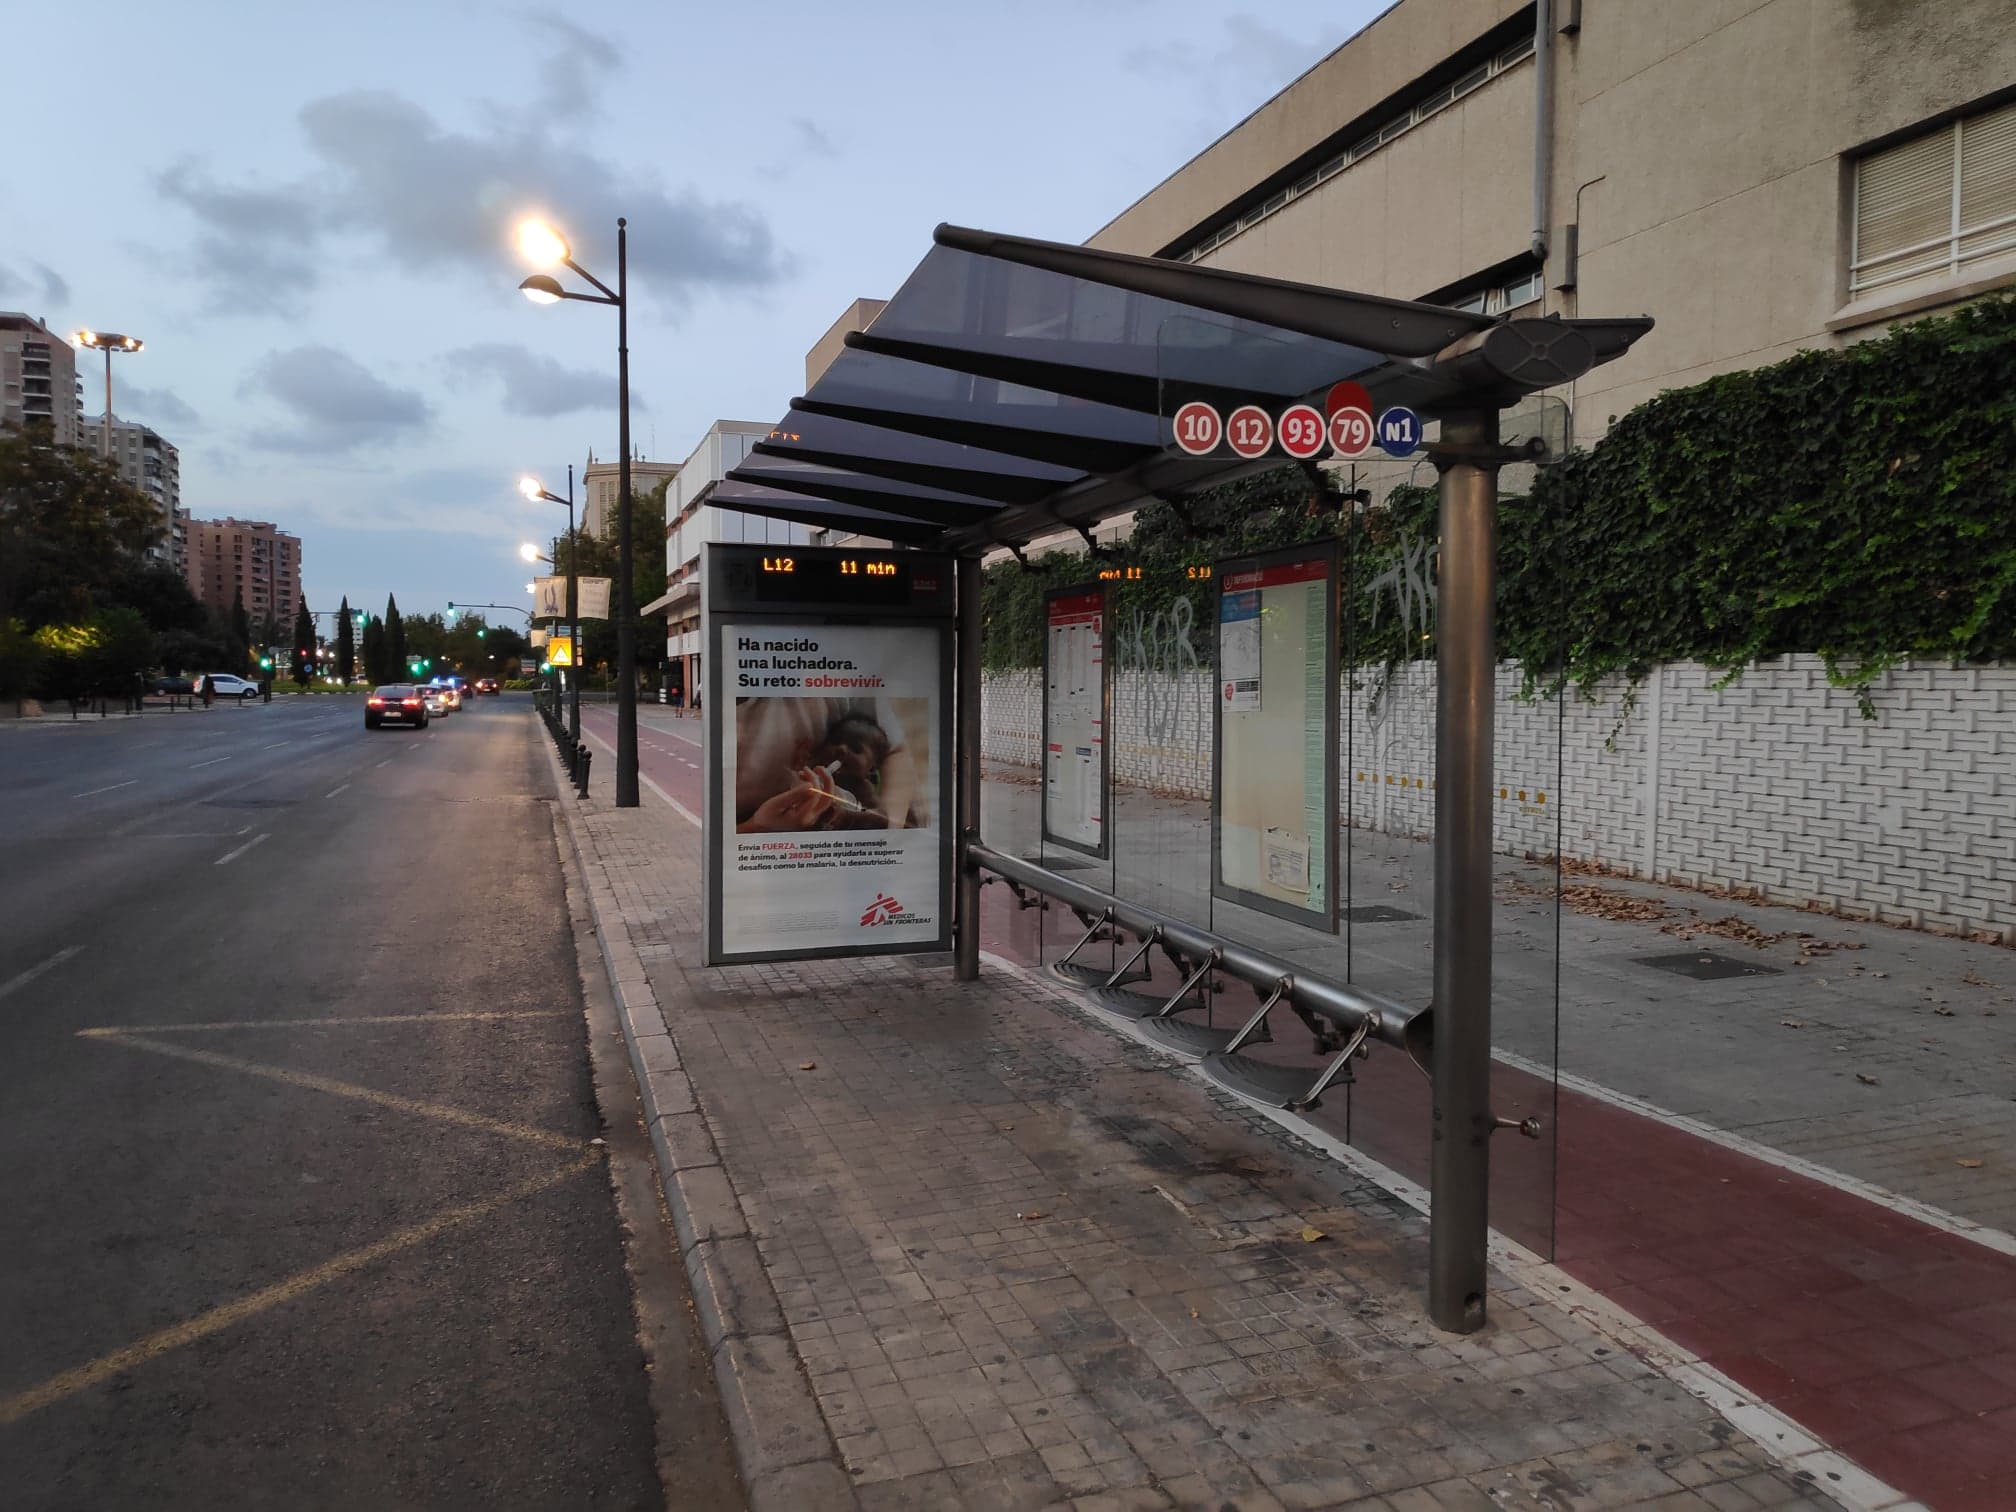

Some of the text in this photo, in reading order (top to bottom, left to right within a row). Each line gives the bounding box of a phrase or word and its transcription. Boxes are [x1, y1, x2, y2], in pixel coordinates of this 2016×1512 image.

[1184, 414, 1213, 442] 10
[1236, 419, 1264, 446] 12
[1287, 418, 1317, 446] 93
[1336, 418, 1366, 445] 79
[1385, 418, 1413, 442] N1
[762, 557, 897, 575] L12 11 min
[738, 637, 819, 652] Ha nacido
[738, 656, 858, 671] una luchadora.
[738, 674, 886, 688] Su reto: sobrevivir.
[799, 840, 832, 850] seguida
[833, 840, 844, 848] de
[845, 840, 853, 848] tu
[854, 839, 888, 848] mensaje
[738, 853, 749, 862] de
[779, 852, 787, 860] al
[814, 852, 832, 861] para
[833, 850, 867, 859] ayudarla
[873, 849, 904, 859] superar
[797, 861, 805, 869] la
[839, 859, 847, 867] la
